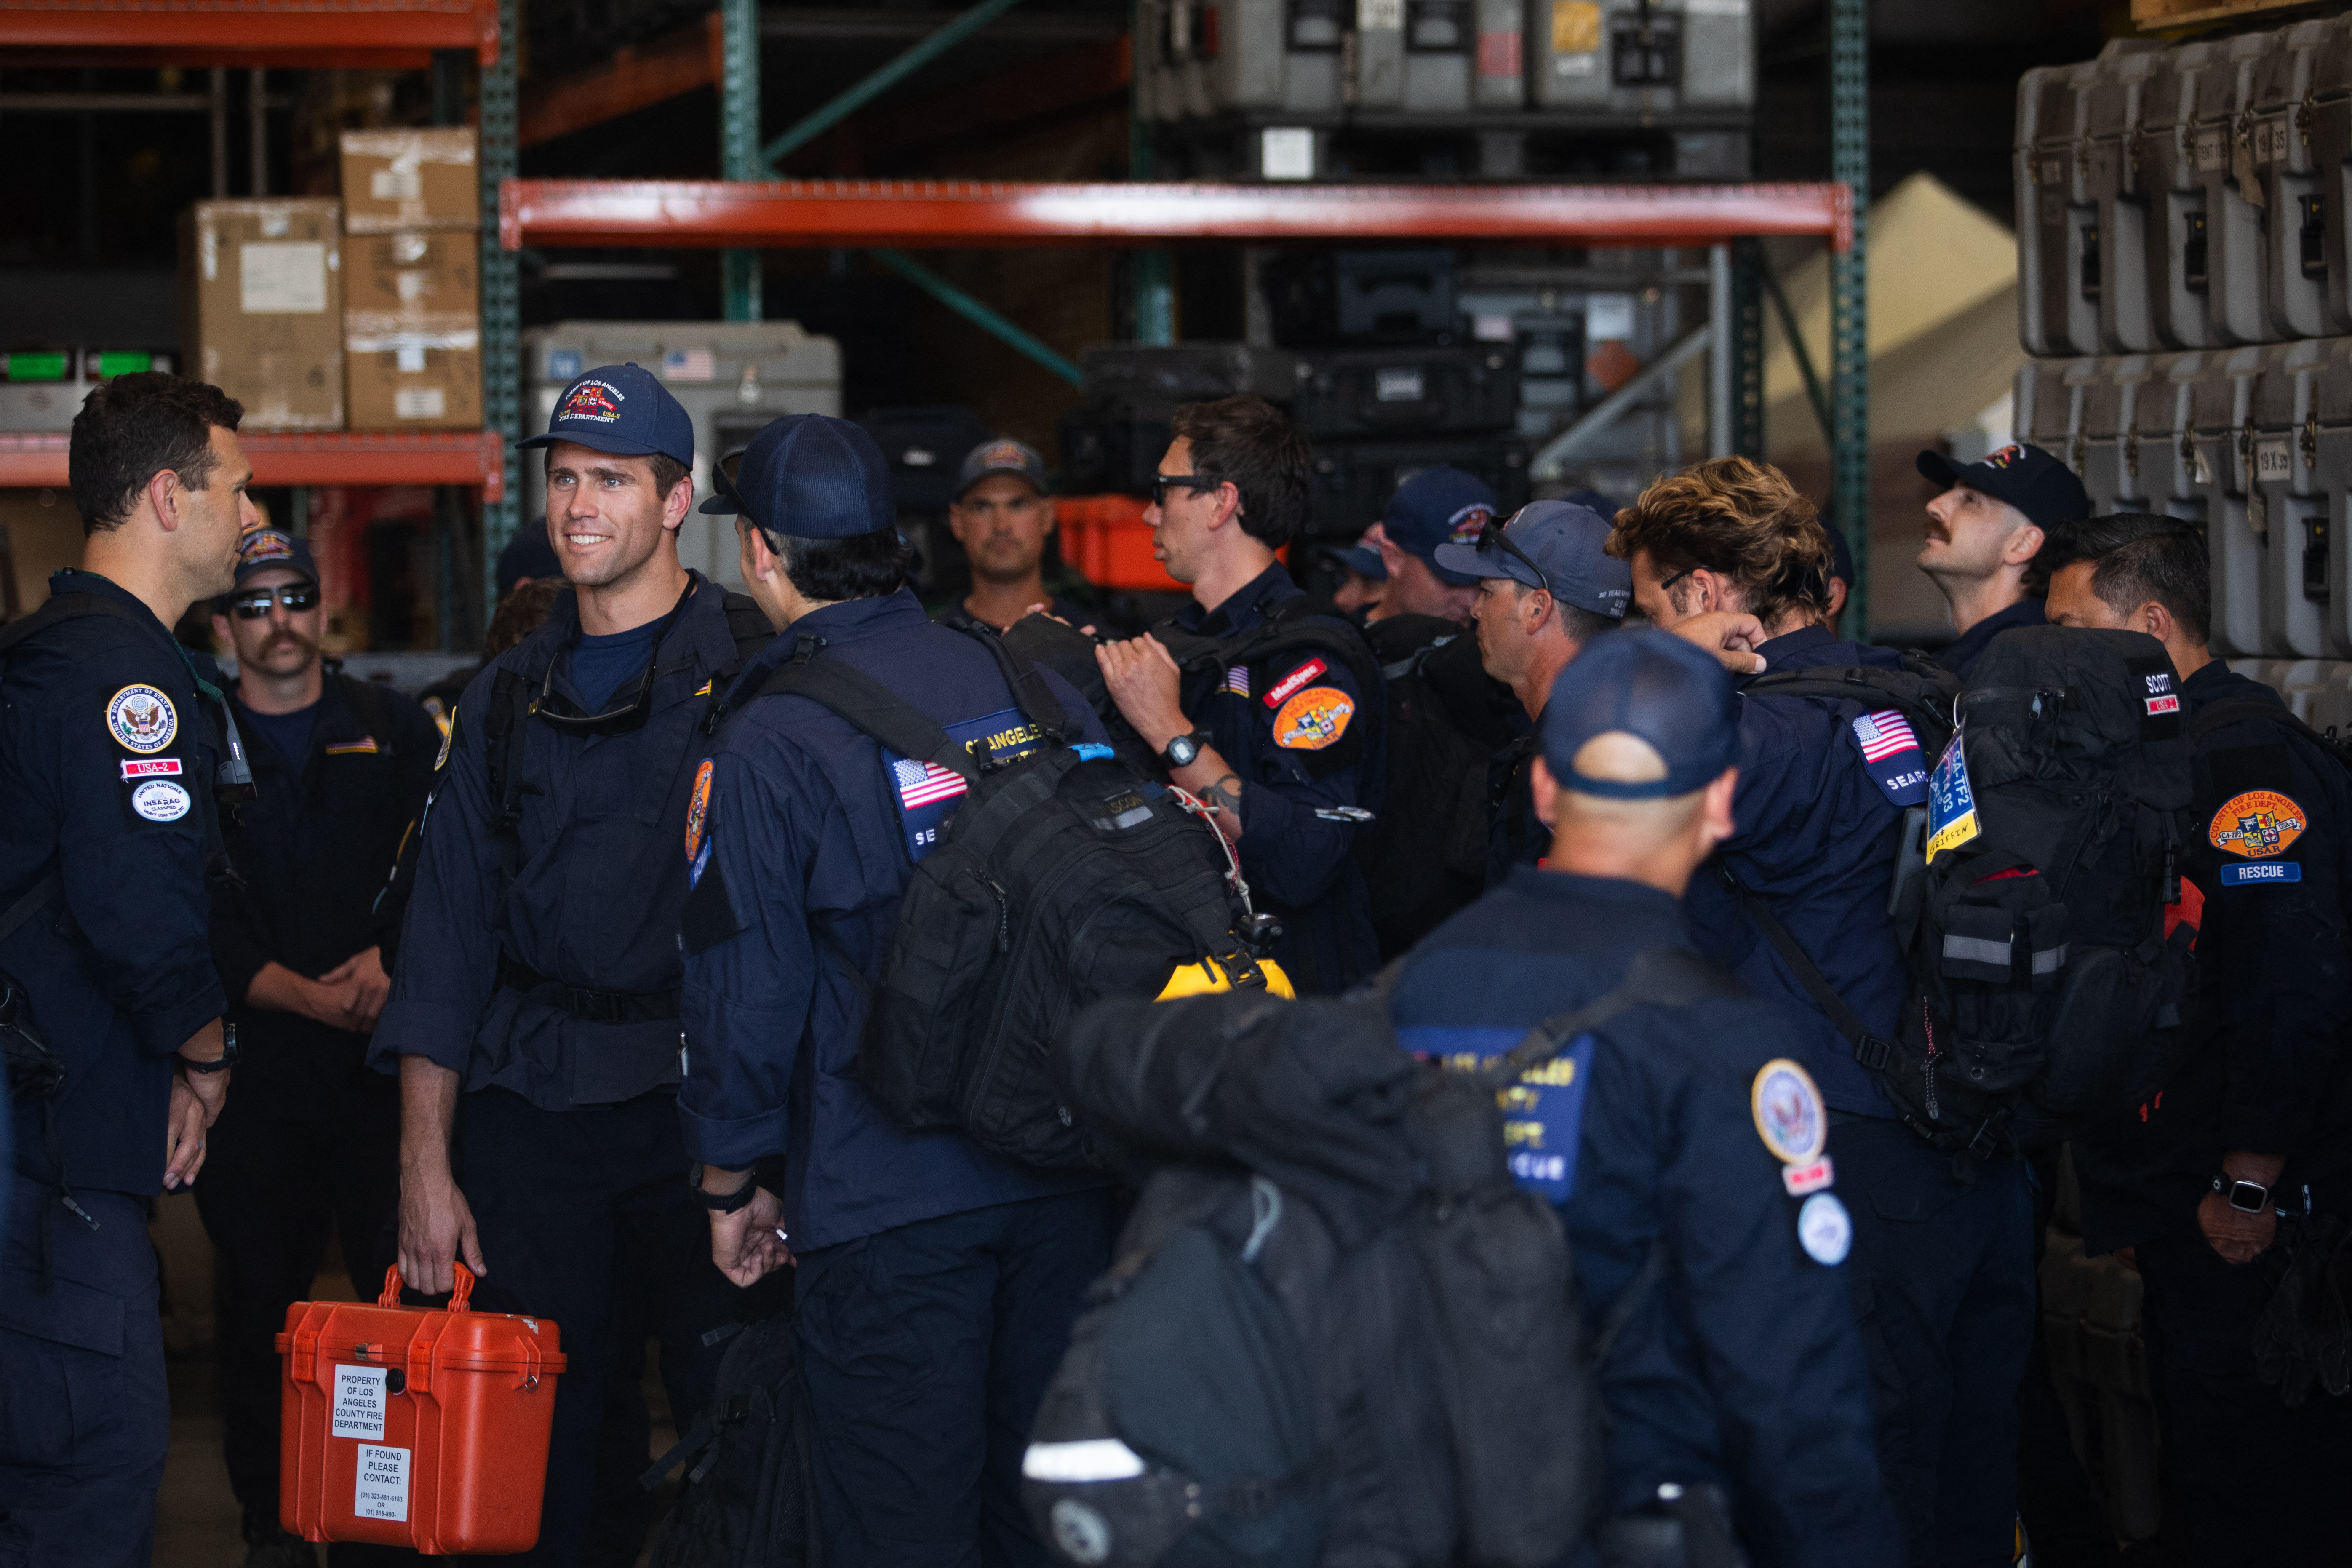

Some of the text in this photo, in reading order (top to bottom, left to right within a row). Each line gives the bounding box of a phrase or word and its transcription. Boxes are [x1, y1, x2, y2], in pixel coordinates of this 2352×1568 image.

[2275, 131, 2285, 150] 35
[601, 382, 625, 401] ANGELES
[573, 407, 597, 415] USAR
[570, 414, 615, 423] DEPARTMENT
[2260, 452, 2269, 471] 19
[2270, 451, 2276, 470] X
[2146, 674, 2170, 693] SCOTT
[112, 688, 142, 713] DEPARTMENT
[154, 693, 170, 709] STATE
[2156, 700, 2168, 710] USA
[113, 722, 129, 743] UNITED
[130, 741, 152, 749] STATES
[163, 718, 174, 743] AMERICA
[987, 724, 1041, 751] ANGELE
[137, 763, 169, 773] USA-2
[1887, 771, 1928, 790] SEARC
[1953, 750, 1970, 806] CA-TF2
[138, 783, 182, 798] UNITED NATIONS
[1943, 793, 1954, 812] 03
[2232, 801, 2277, 816] FIRE DEPT.
[2211, 792, 2304, 838] COUNTY OF LOS ANGELES
[2278, 820, 2294, 829] USA-2
[1930, 823, 1968, 855] GRIFFIN
[2247, 846, 2282, 857] USAR
[2238, 865, 2284, 880] RESCUE
[342, 1375, 380, 1385] PROPERTY
[359, 1388, 373, 1396] LOS
[343, 1398, 376, 1408] ANGELES
[336, 1408, 383, 1420] COUNTY FIRE
[335, 1420, 383, 1431] DEPARTMENT
[375, 1450, 401, 1461] FOUND
[368, 1461, 398, 1472] PLEASE
[364, 1473, 401, 1485] CONTACT:
[371, 1493, 403, 1502] 323-881-6183
[376, 1510, 402, 1518] 818-890-
